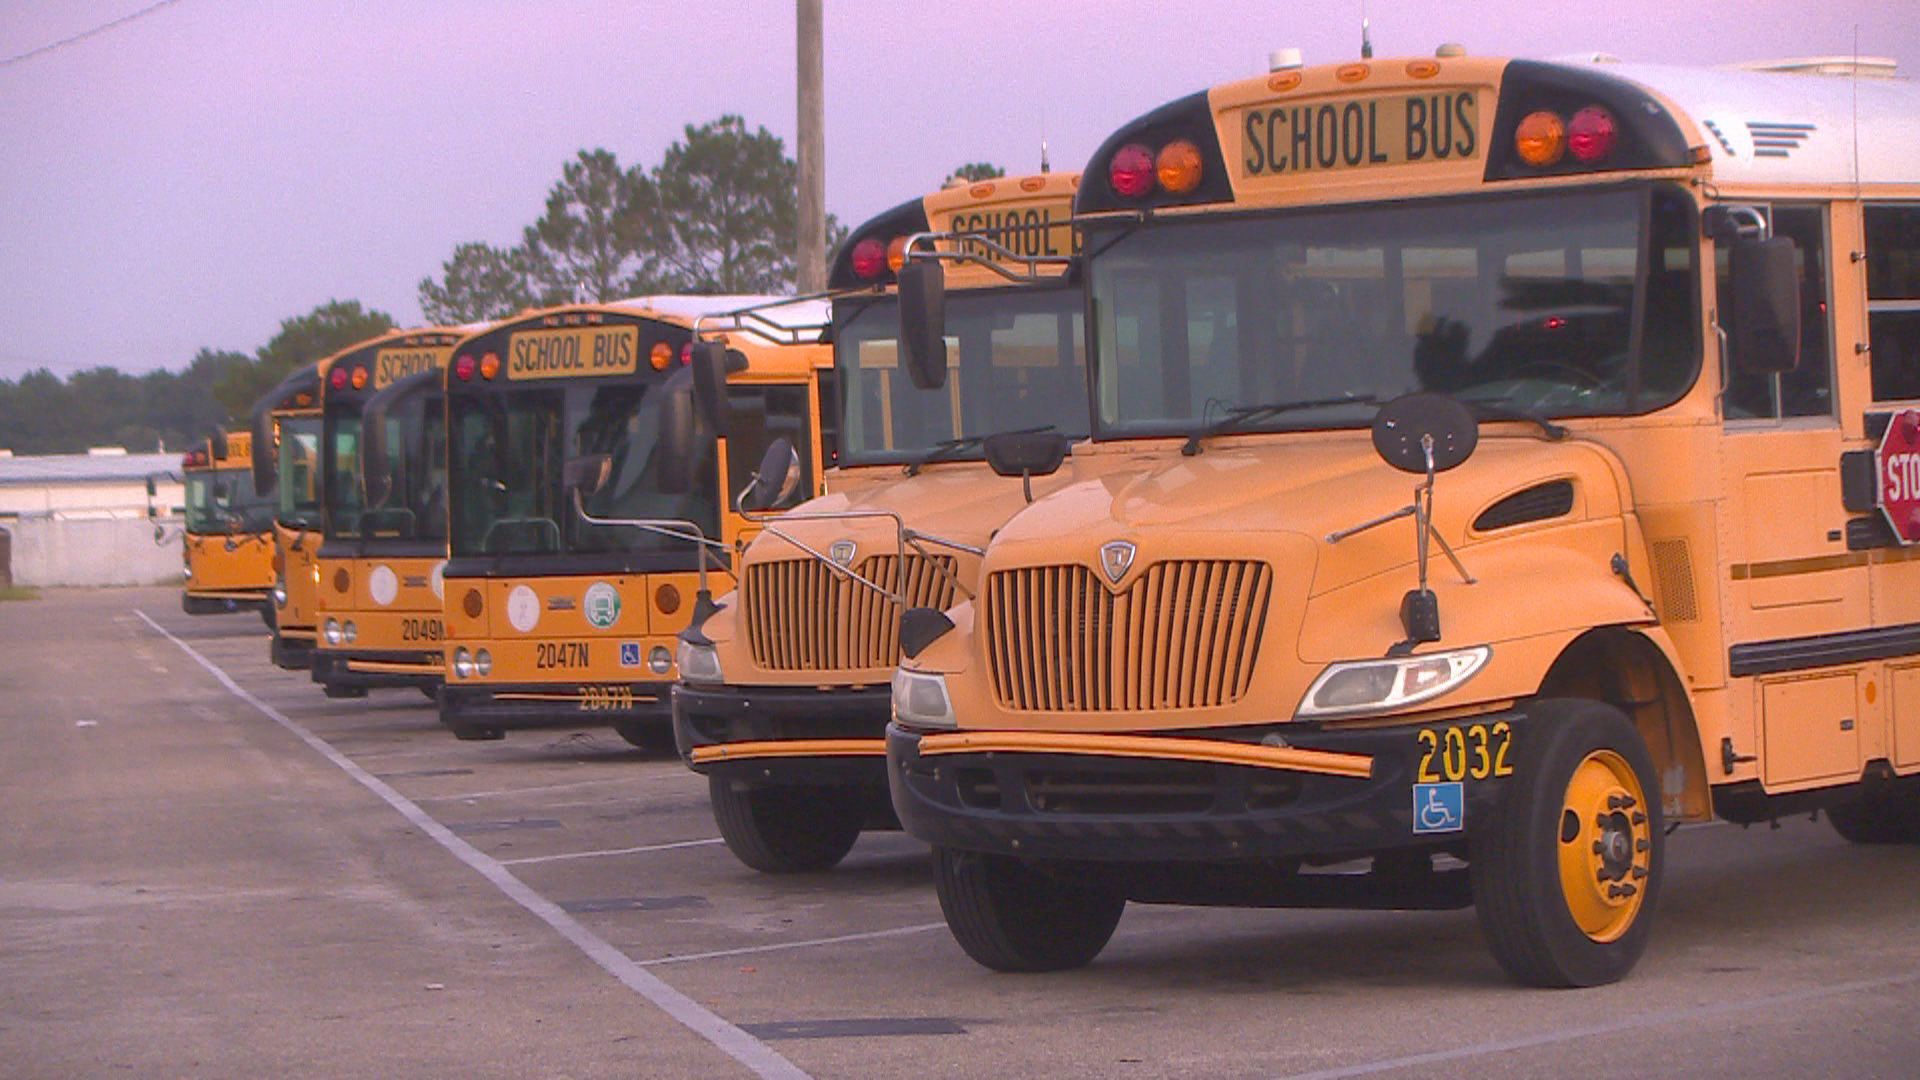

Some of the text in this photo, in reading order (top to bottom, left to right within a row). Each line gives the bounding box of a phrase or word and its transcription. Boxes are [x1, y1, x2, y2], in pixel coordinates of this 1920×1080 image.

[1246, 92, 1475, 174] SCHOOL BUS
[513, 332, 632, 372] SCHOOL BUS
[537, 643, 589, 668] 2047N
[579, 686, 633, 711] 2047N
[1418, 721, 1513, 783] 2032
